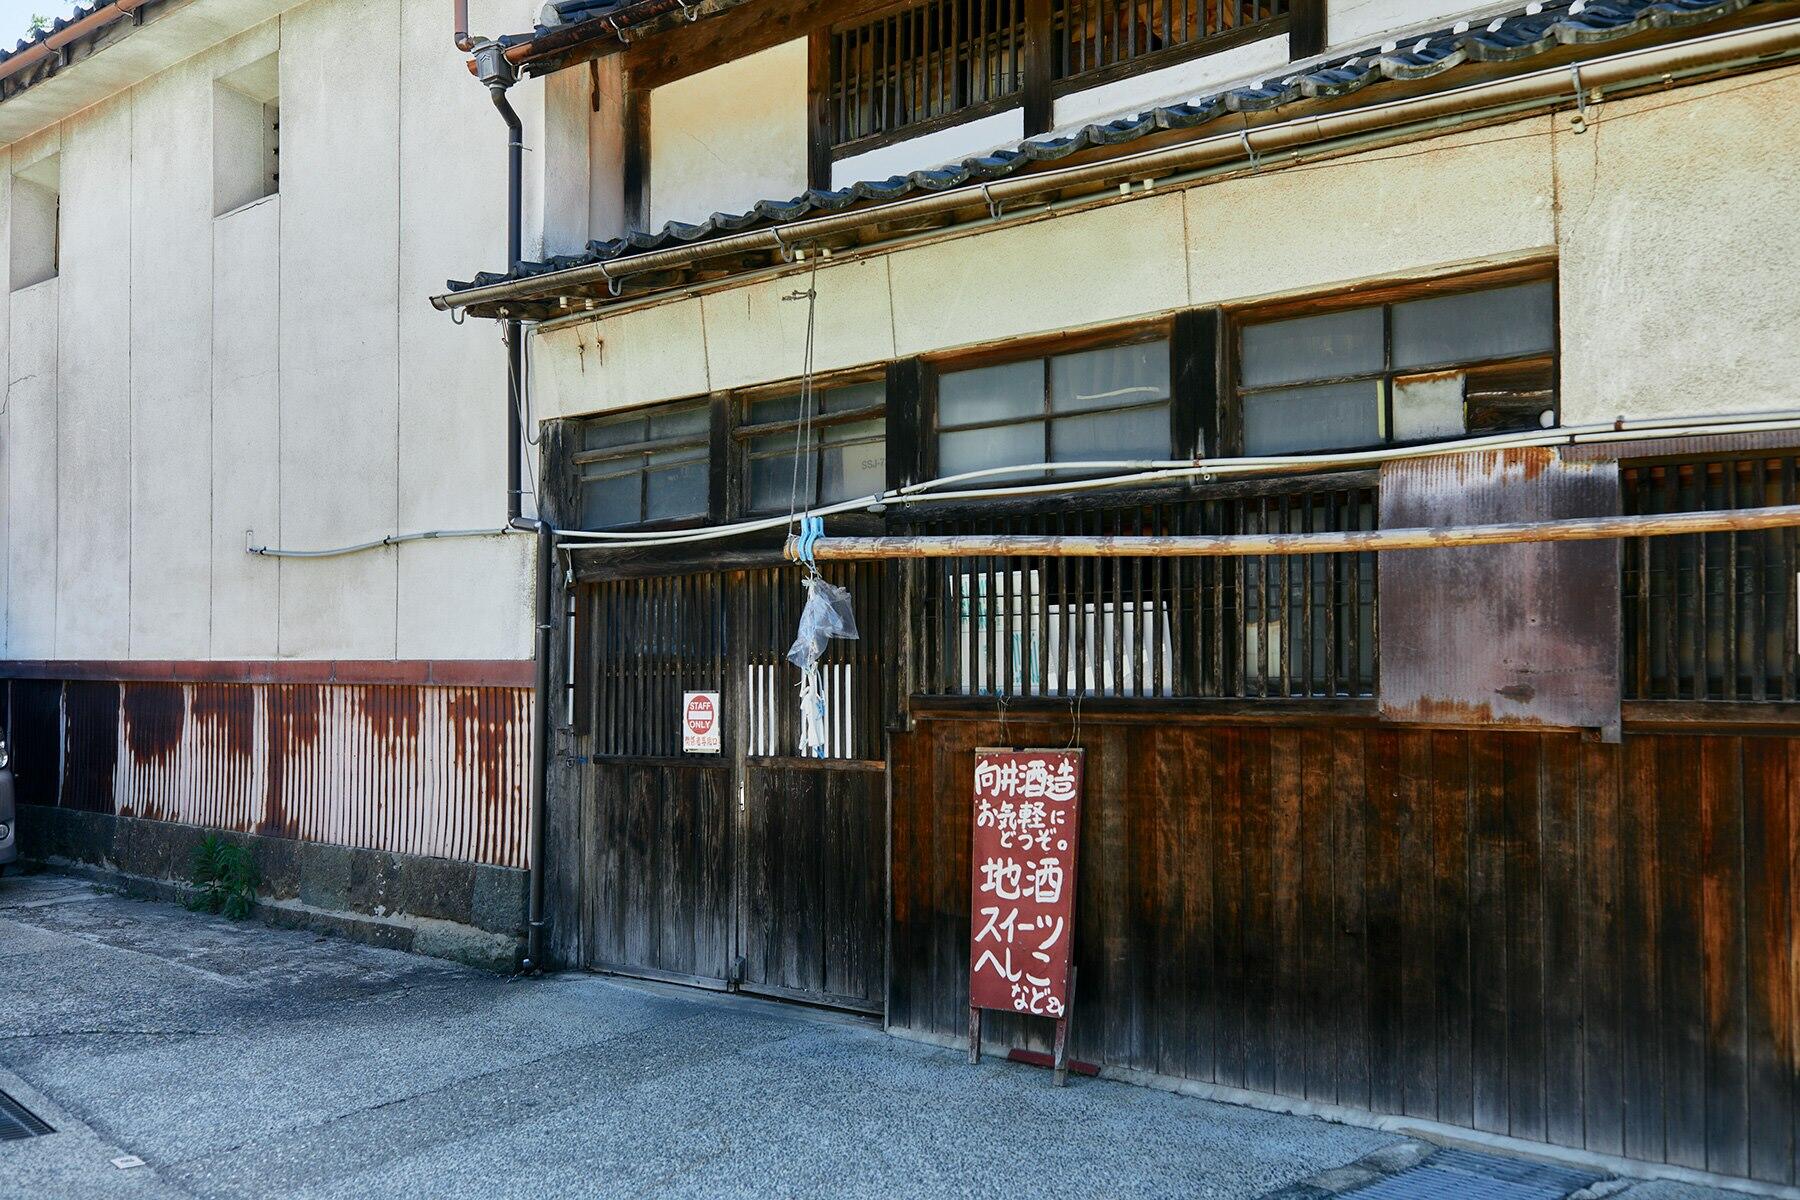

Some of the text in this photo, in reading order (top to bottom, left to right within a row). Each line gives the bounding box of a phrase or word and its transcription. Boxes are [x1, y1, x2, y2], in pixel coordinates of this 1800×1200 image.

[690, 701, 711, 711] STAFF
[690, 720, 711, 729] ONLY
[975, 757, 1076, 802] 向井酒造
[977, 799, 1066, 831] お気軽に
[980, 856, 1063, 904] 地酒
[974, 906, 1064, 950] スイーツ
[974, 946, 1051, 987] へしこ
